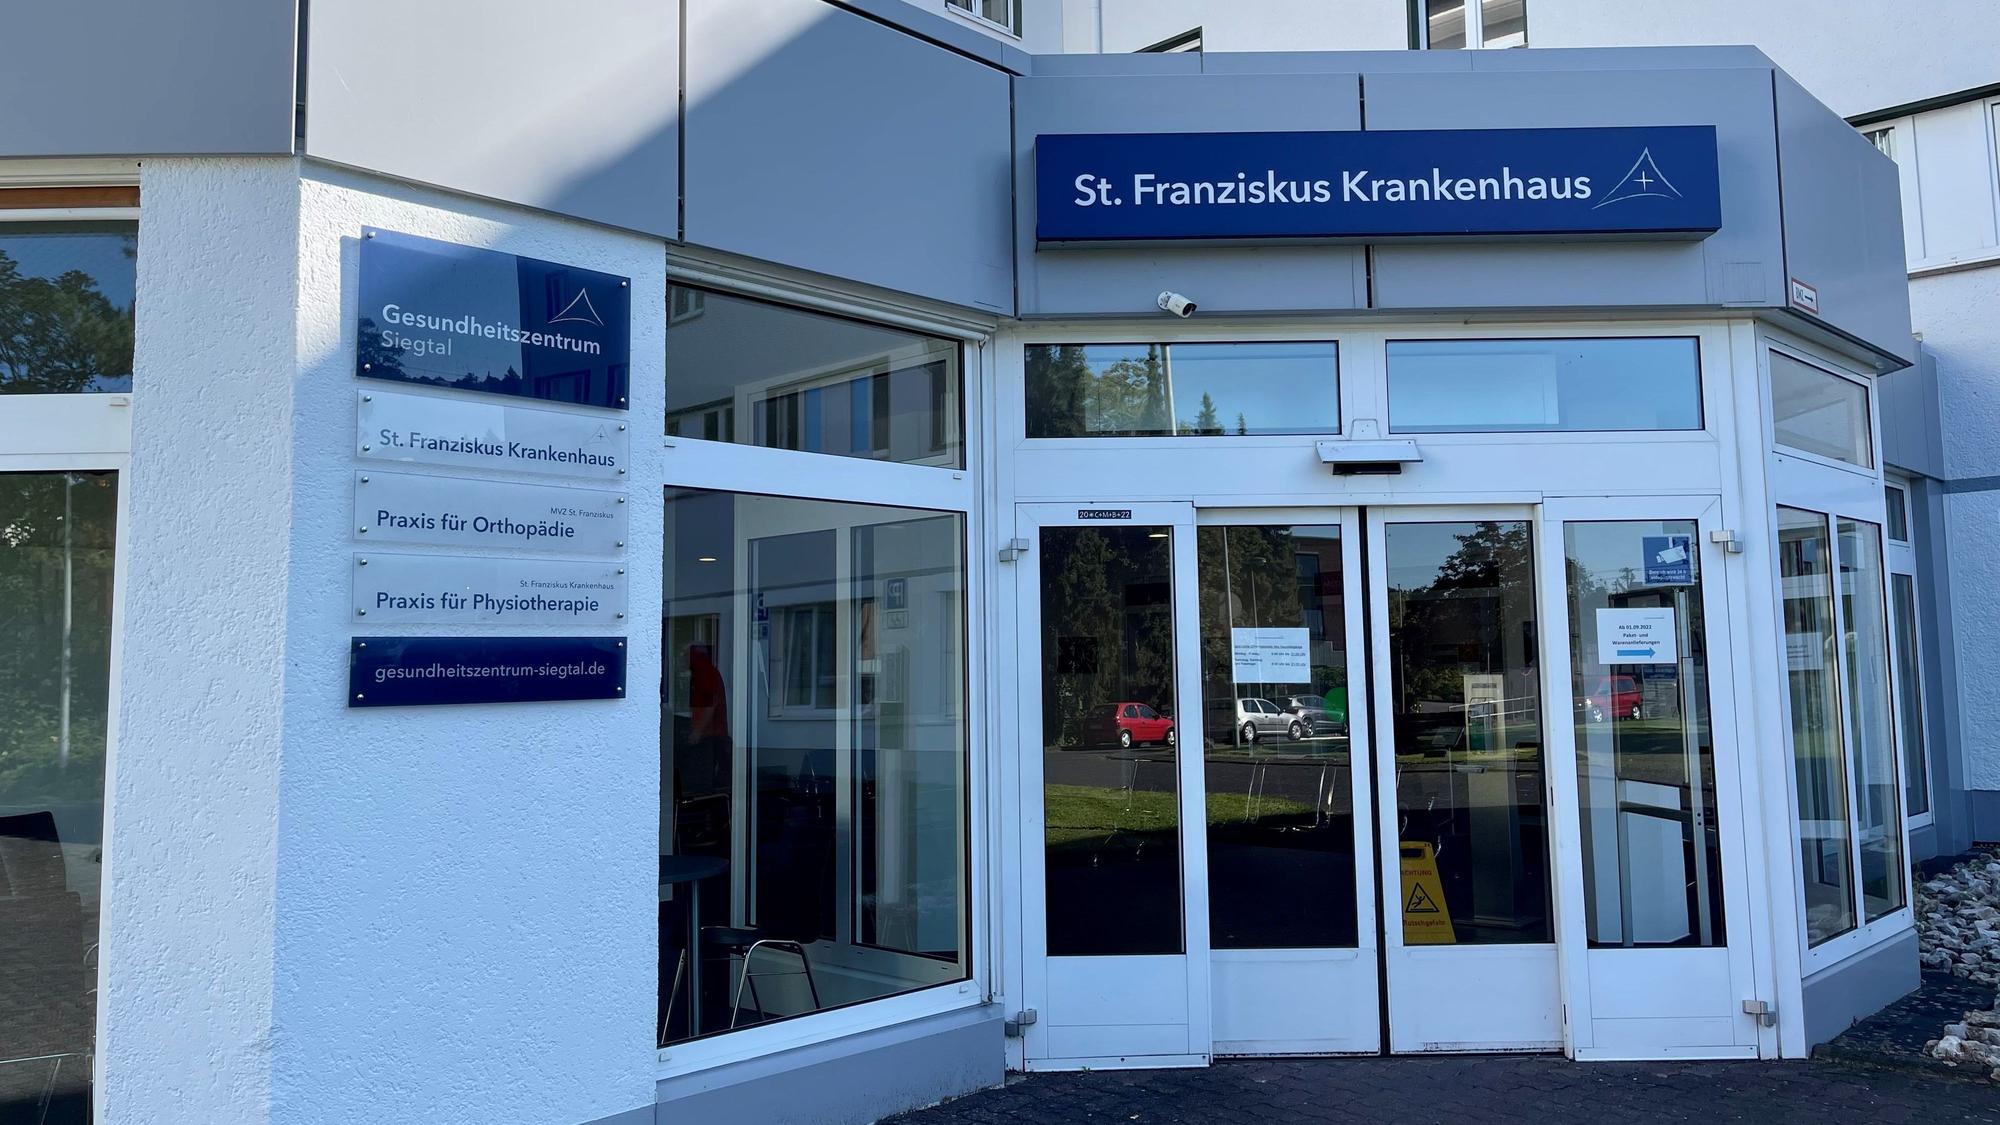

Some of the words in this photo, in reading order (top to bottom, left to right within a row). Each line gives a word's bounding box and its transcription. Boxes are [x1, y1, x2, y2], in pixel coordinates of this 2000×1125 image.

[1074, 173, 1121, 206] St.
[1134, 170, 1331, 206] Franziskus
[1341, 166, 1592, 203] Krankenhaus
[382, 303, 601, 355] Gesundheitszentrum
[380, 330, 452, 357] Siegtal
[379, 428, 404, 449] St.
[409, 432, 504, 457] Franziskus
[508, 442, 616, 467] Krankenhaus
[376, 509, 436, 530] Praxis
[441, 512, 467, 533] für
[472, 515, 576, 540] Orthopädie
[550, 506, 567, 516] MVZ
[568, 508, 578, 517] St.
[578, 509, 614, 519] Franziskus
[519, 579, 529, 589] St.
[530, 580, 568, 590] Franziskus
[569, 581, 615, 590] Krankenhaus
[375, 591, 436, 610] Praxis
[440, 592, 467, 611] für
[473, 593, 600, 616] Physiotherapie
[374, 660, 606, 683] gesundheitszentrum-siegtal.de
